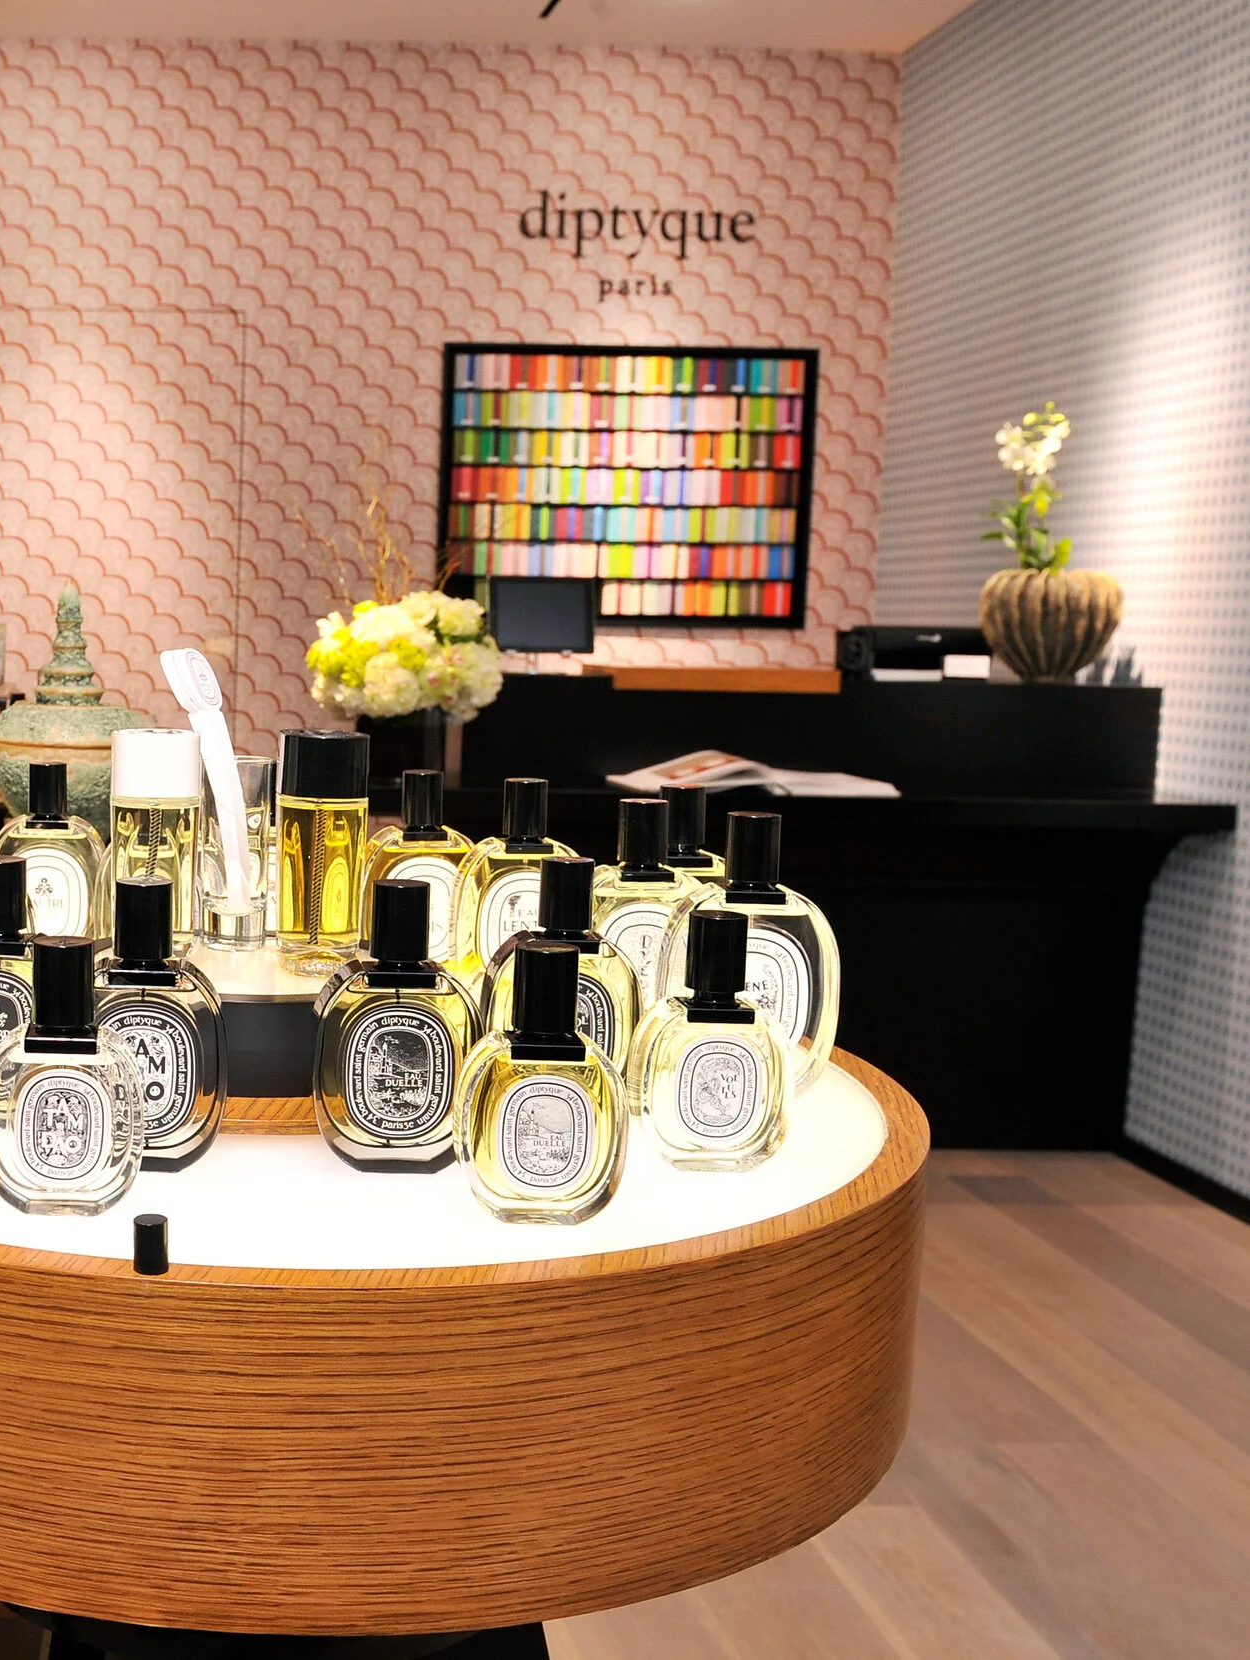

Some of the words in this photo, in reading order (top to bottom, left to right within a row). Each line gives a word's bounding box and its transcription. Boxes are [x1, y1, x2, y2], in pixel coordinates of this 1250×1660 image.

[519, 190, 755, 260] diptyque
[598, 274, 673, 303] paris
[124, 1016, 162, 1026] diptyque
[381, 1017, 420, 1026] diptyque
[172, 1030, 187, 1071] boulevard
[357, 1022, 378, 1052] germain
[430, 1031, 443, 1071] boulevard
[354, 1054, 362, 1073] saint
[178, 1074, 186, 1094] saint
[354, 1076, 368, 1118] boulevard
[434, 1074, 443, 1093] saint
[43, 1098, 83, 1130] TAM
[161, 1094, 182, 1124] germain
[417, 1095, 438, 1125] germain
[509, 1091, 527, 1117] germain
[530, 1086, 563, 1094] diptyque
